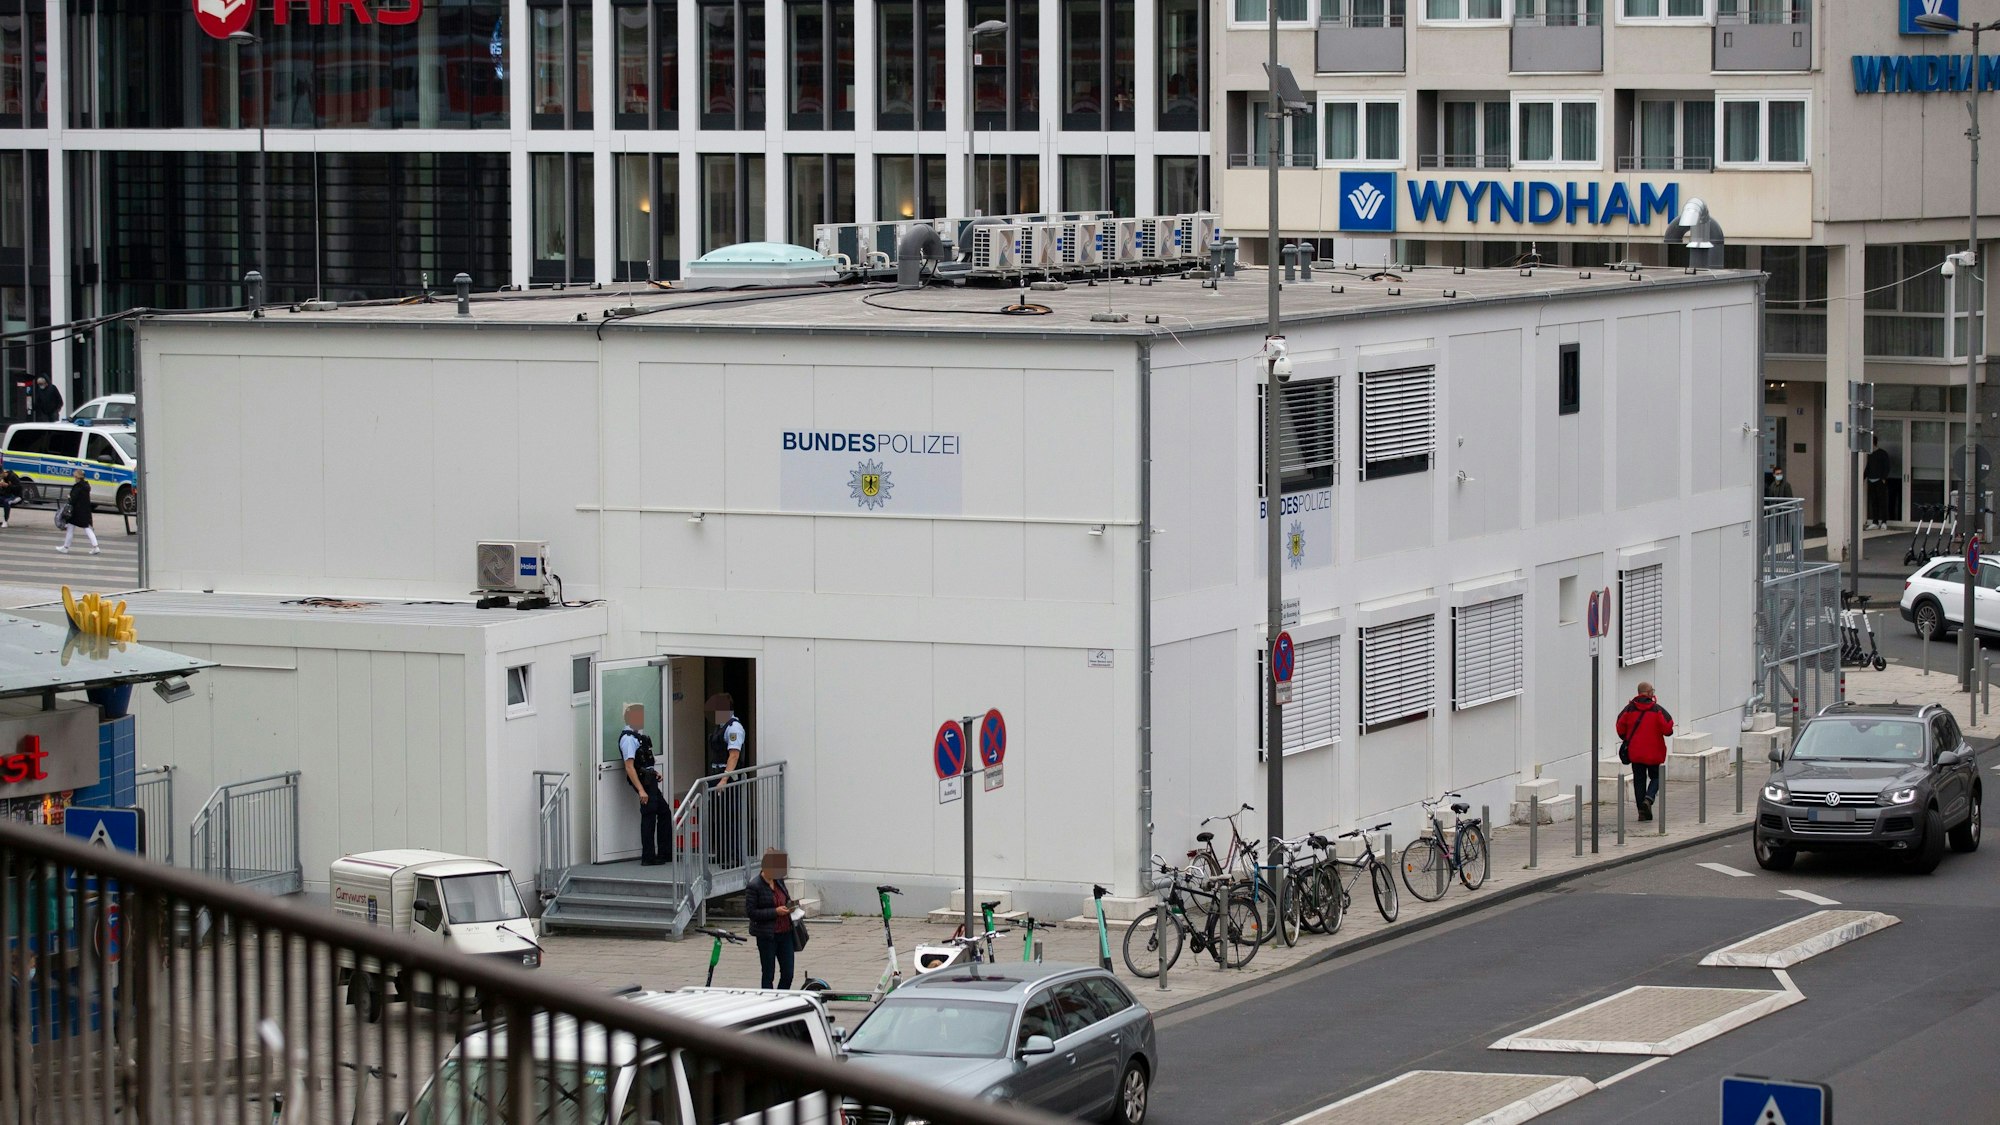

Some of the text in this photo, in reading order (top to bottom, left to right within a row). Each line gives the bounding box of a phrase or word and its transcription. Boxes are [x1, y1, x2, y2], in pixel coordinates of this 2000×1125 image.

[1407, 180, 1679, 225] WYNDHAM
[783, 432, 960, 454] BUNDESPOLIZEI
[46, 465, 73, 476] POLIZEI
[1260, 491, 1332, 519] BDESPOLIZEI
[336, 887, 367, 904] Currywurst
